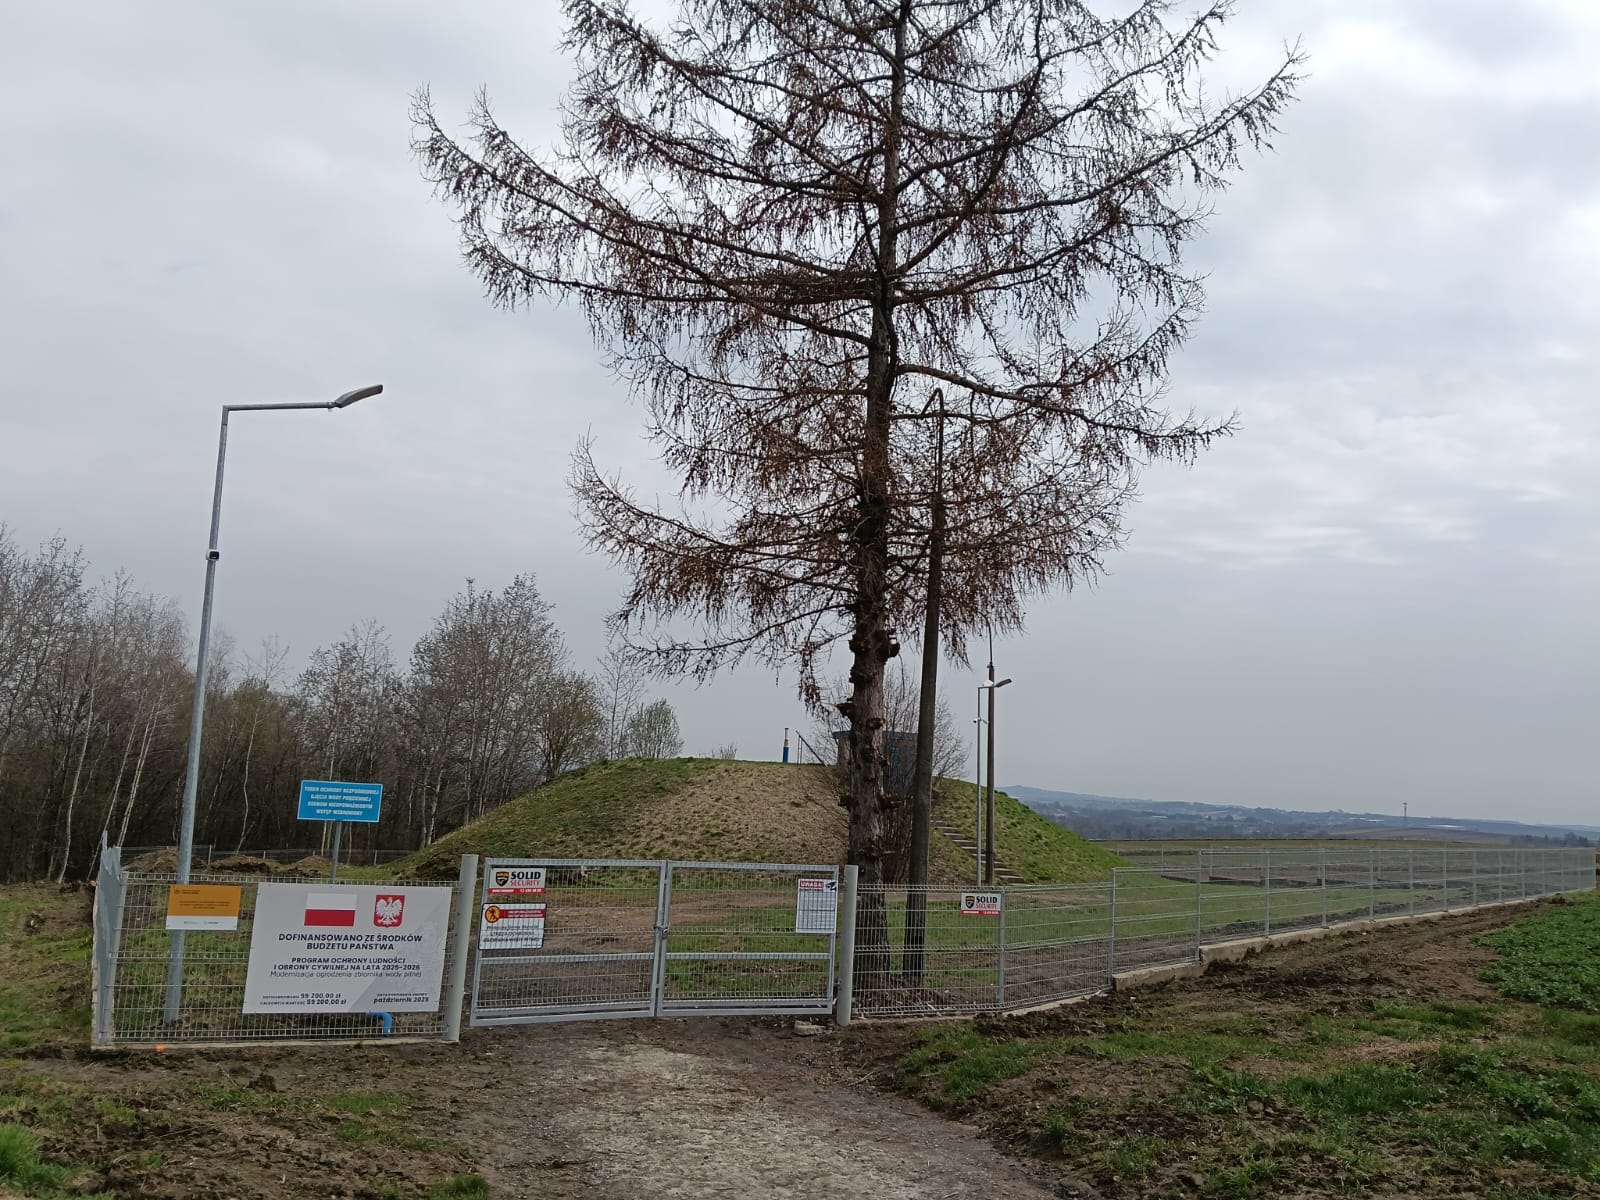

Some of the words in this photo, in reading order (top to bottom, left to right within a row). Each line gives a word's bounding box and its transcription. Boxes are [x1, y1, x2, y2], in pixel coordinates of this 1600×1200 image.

[510, 871, 541, 880] SOLID
[278, 933, 363, 942] DOFINANSOWANO
[364, 934, 376, 942] ZE
[376, 932, 423, 942] ŚRODKÓW
[349, 941, 394, 950] PAŃSTWA
[369, 956, 406, 964] LUDNOŚCI
